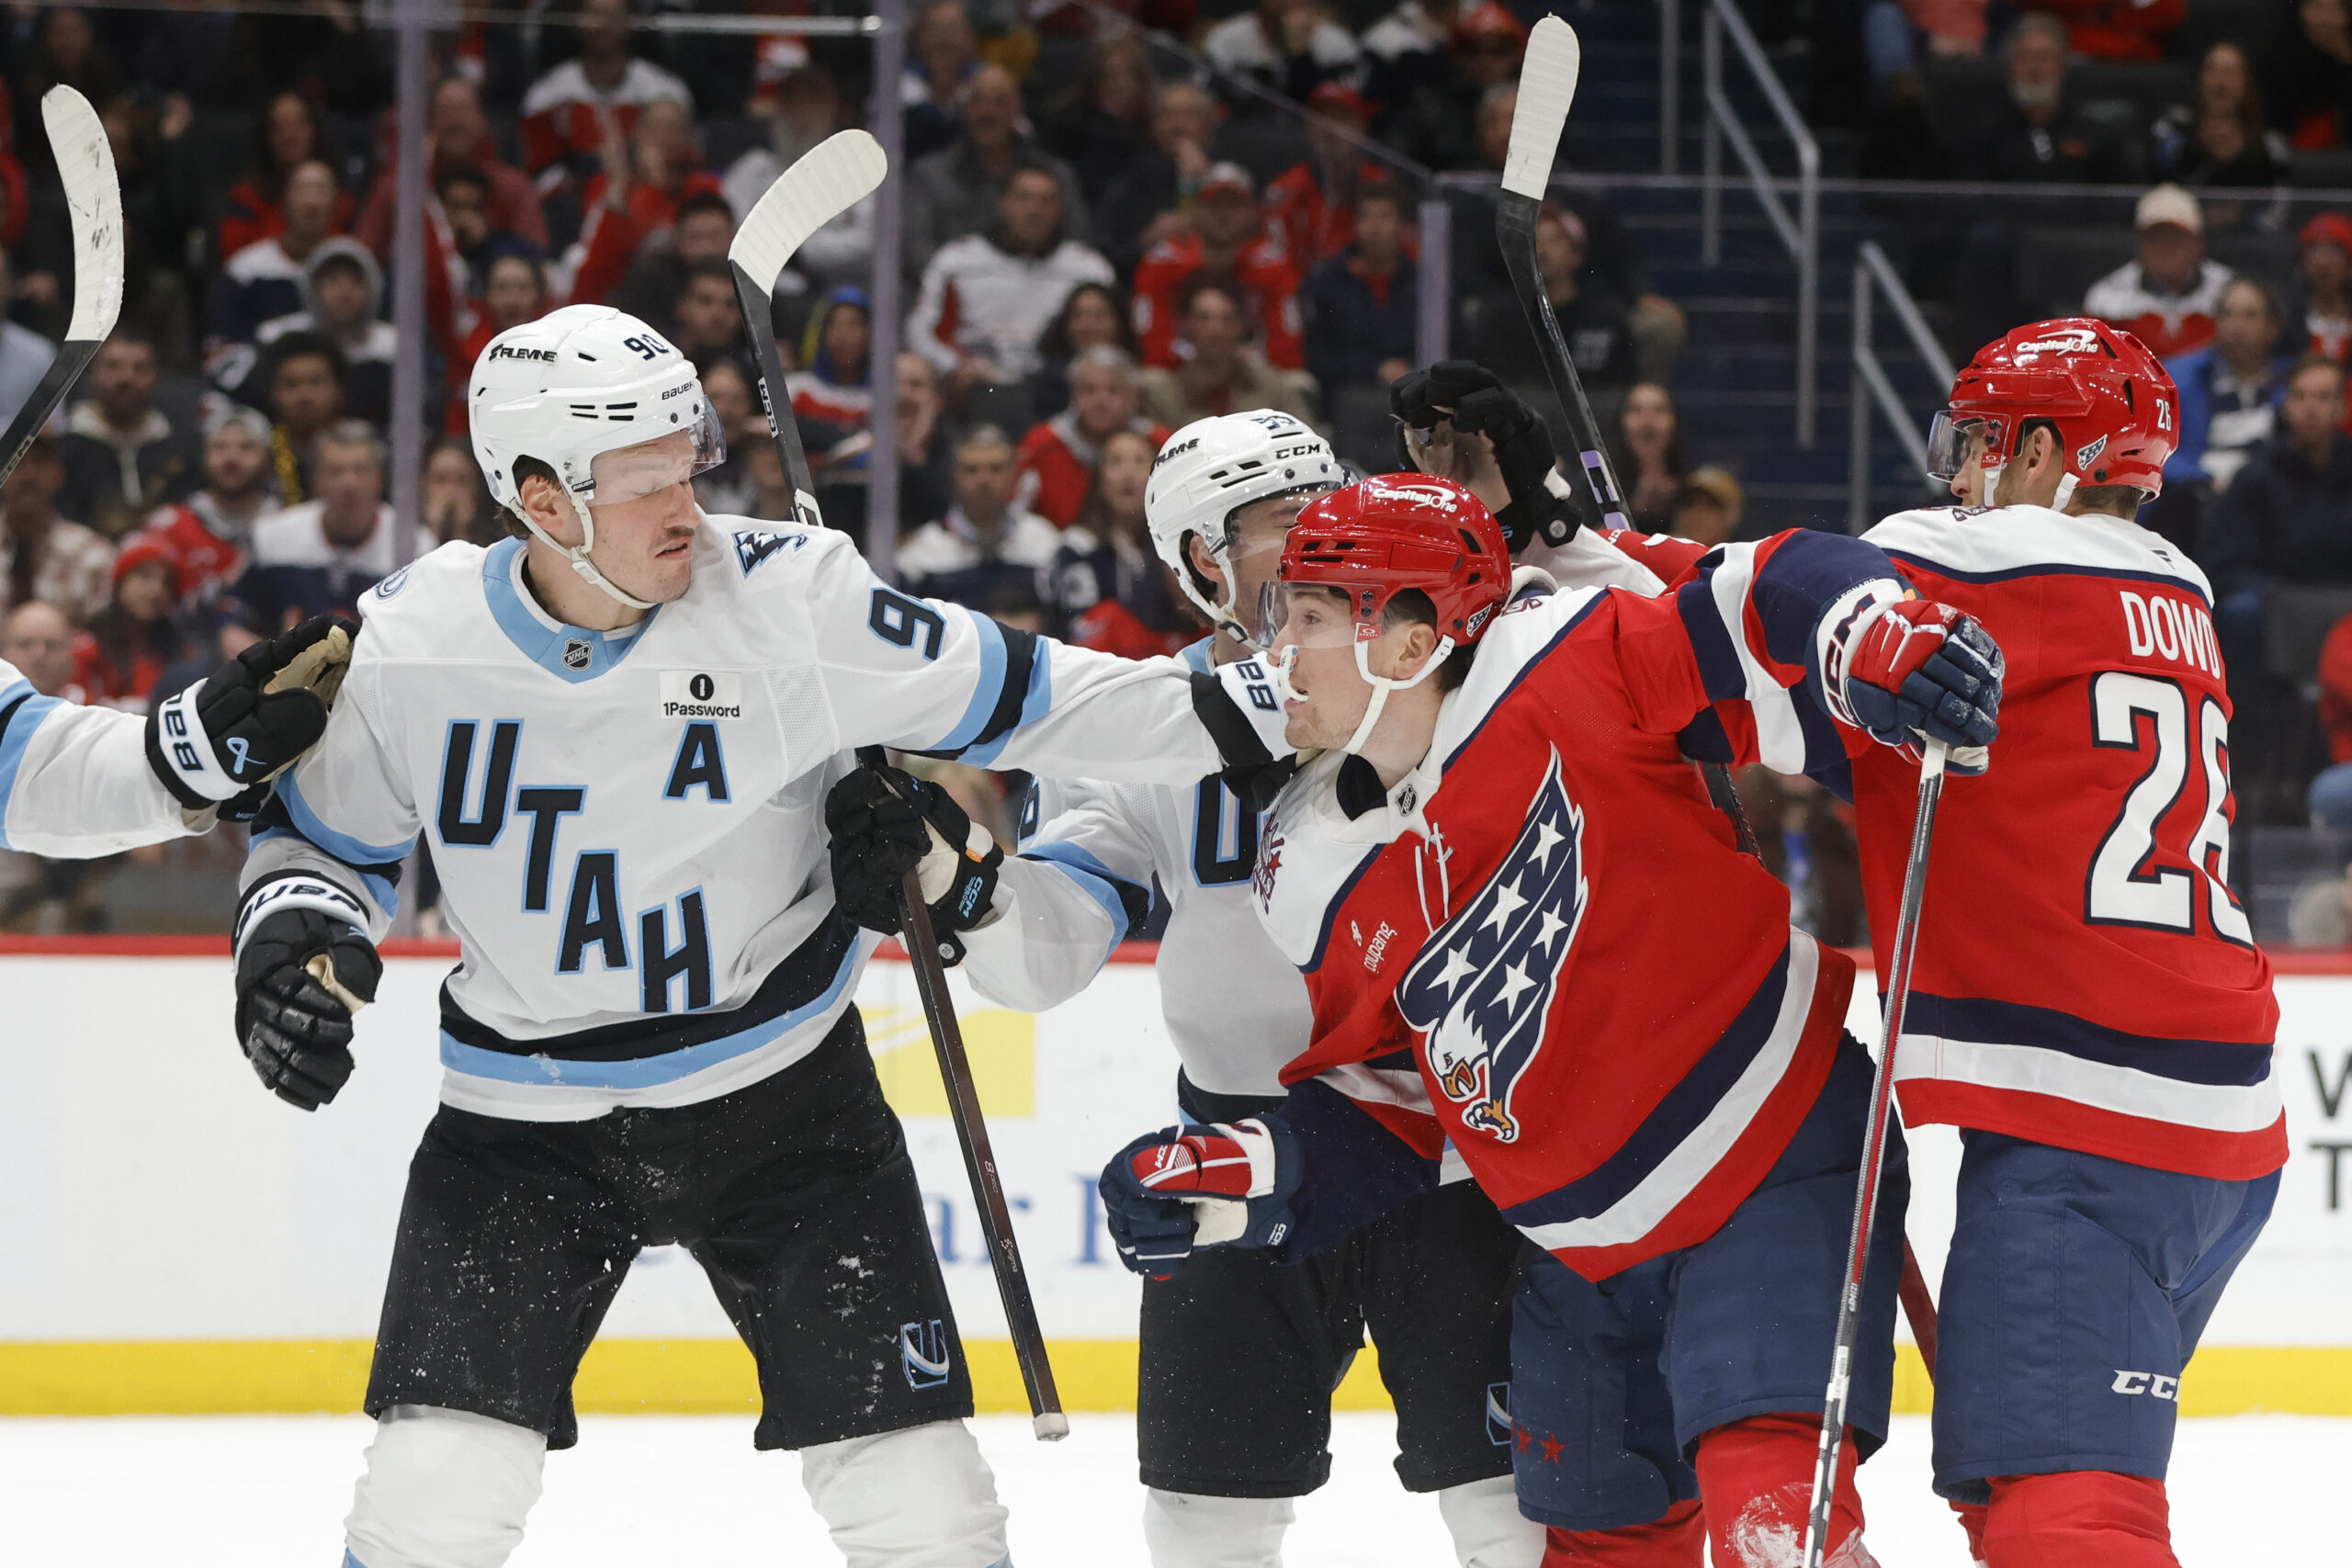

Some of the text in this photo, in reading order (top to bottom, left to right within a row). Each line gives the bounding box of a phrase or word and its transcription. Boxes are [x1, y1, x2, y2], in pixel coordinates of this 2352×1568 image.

[499, 347, 558, 363] FILEVINE
[759, 382, 777, 434] CCM
[2155, 399, 2173, 432] 26
[1274, 444, 1320, 459] CCM
[566, 648, 588, 663] NHL
[2119, 590, 2222, 681] DOWD
[662, 702, 741, 718] 1Password
[662, 719, 732, 804] A
[2083, 670, 2255, 953] 26
[435, 716, 716, 1014] UTAH
[963, 876, 984, 919] CCM
[1363, 920, 1397, 973] coupang
[2110, 1369, 2180, 1404] CC
